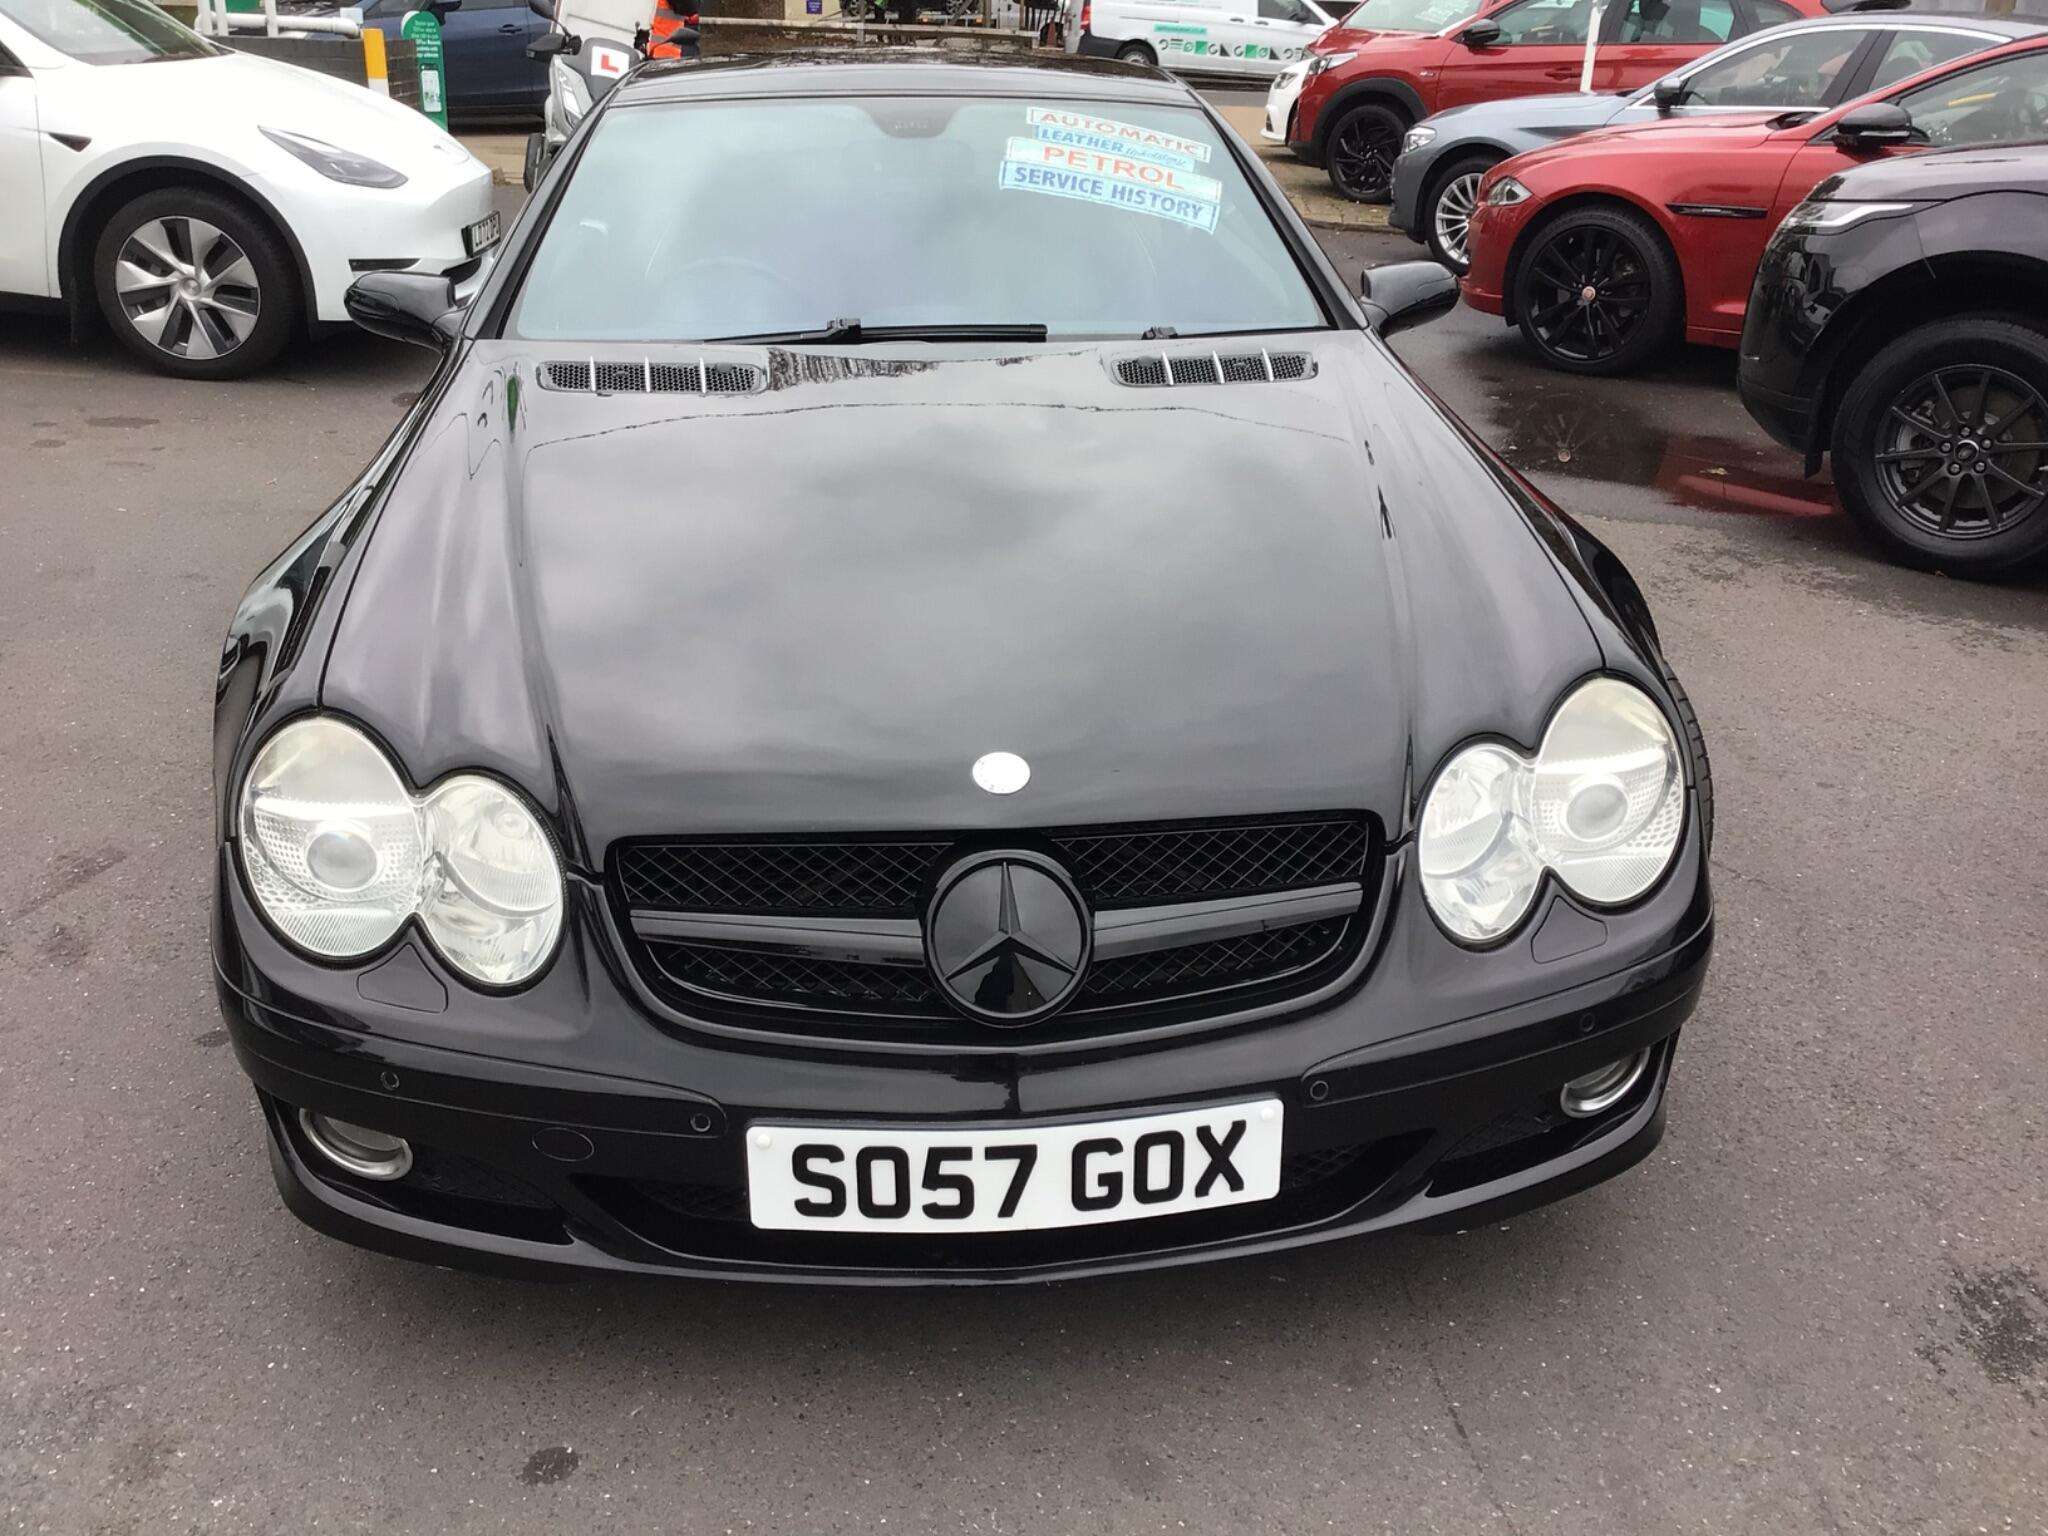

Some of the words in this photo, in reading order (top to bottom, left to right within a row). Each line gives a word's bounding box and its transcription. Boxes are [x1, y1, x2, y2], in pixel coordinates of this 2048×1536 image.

[601, 54, 619, 73] L
[1040, 112, 1197, 155] AUTOMATIC
[1042, 127, 1124, 153] LEATHER
[1043, 146, 1184, 190] PETROL
[1014, 166, 1104, 196] SERVICE
[1111, 184, 1204, 220] HISTORY
[791, 1143, 1038, 1220] SO57
[1070, 1119, 1247, 1212] GOX
